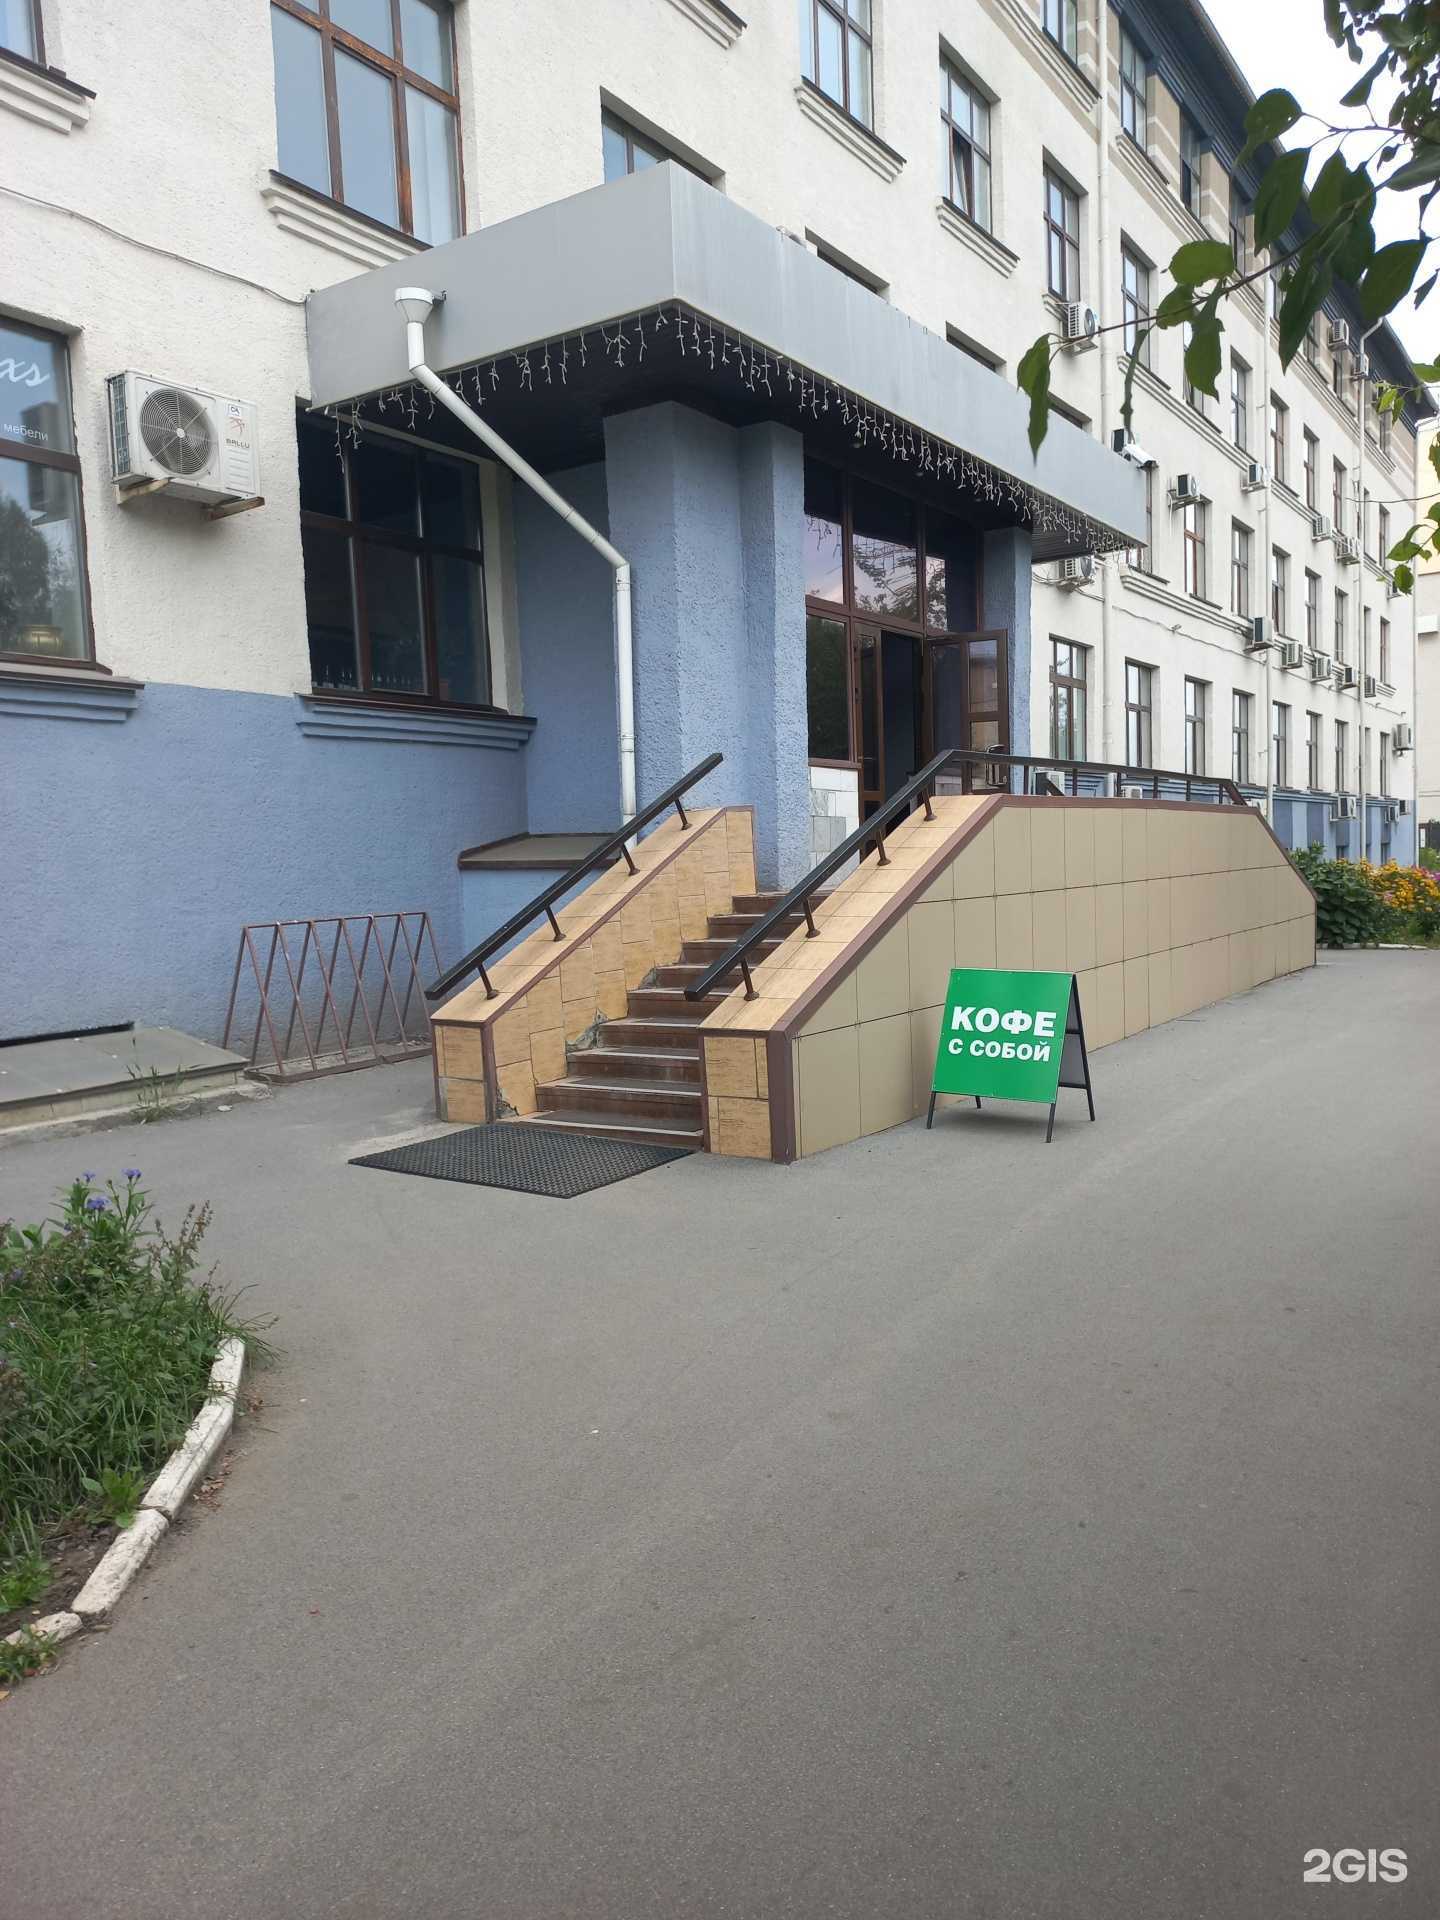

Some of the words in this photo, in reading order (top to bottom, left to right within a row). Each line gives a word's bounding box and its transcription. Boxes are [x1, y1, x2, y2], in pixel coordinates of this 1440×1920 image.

[3, 423, 49, 441] мебели
[951, 1006, 1057, 1037] КОФЕ
[970, 1040, 1051, 1061] СОБОЙ
